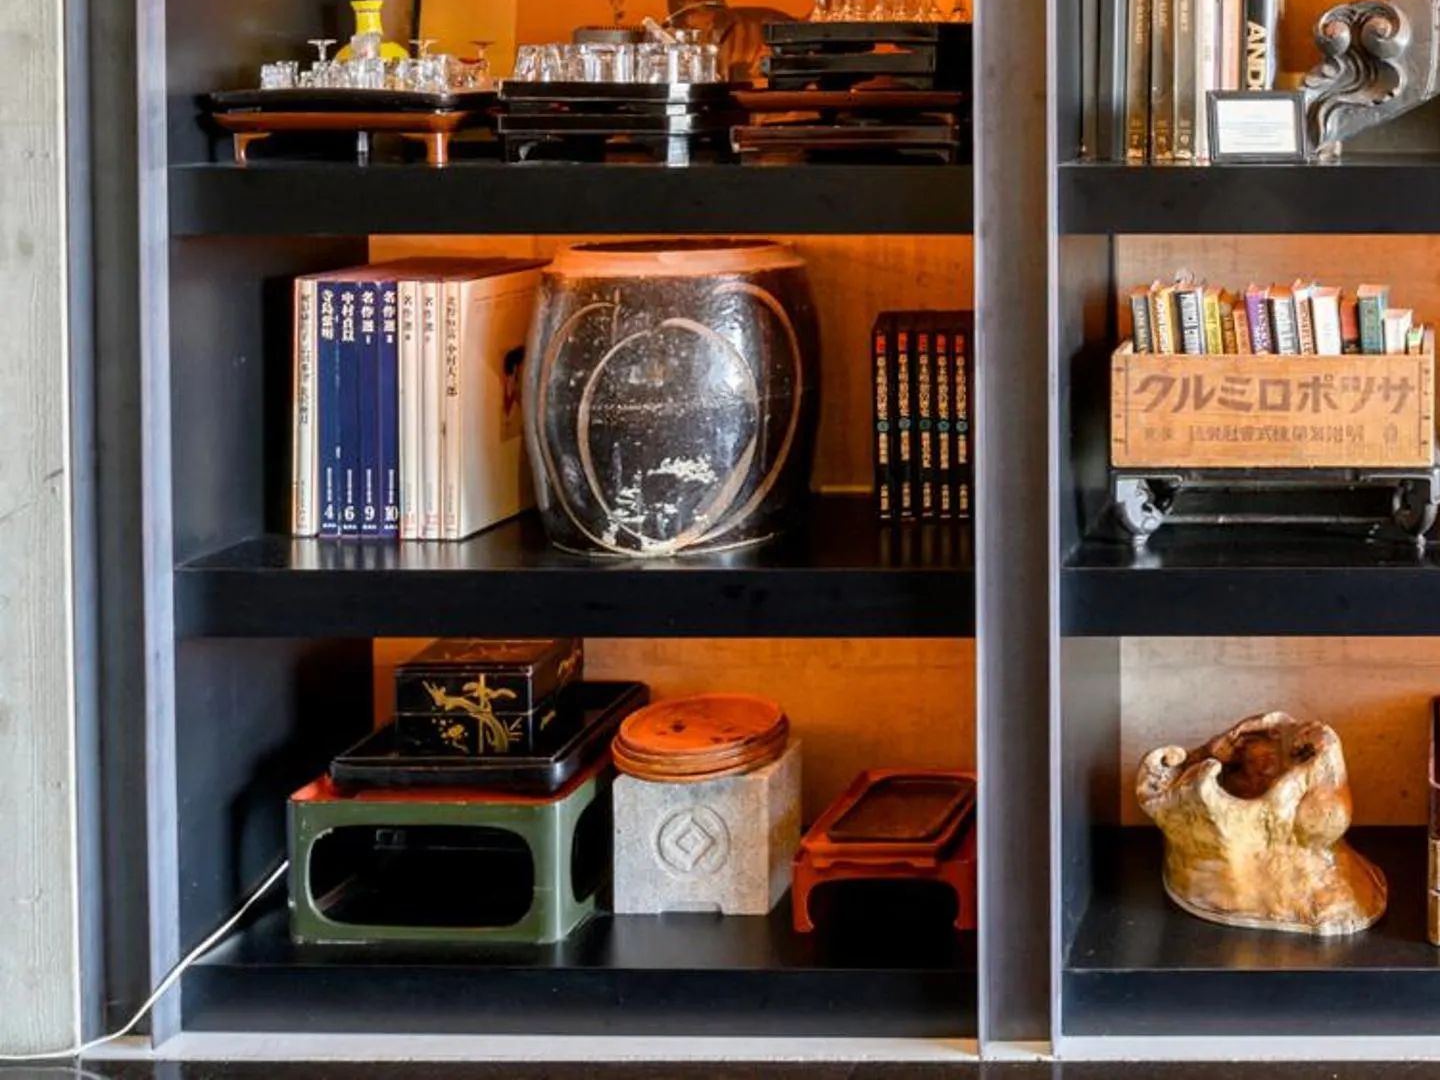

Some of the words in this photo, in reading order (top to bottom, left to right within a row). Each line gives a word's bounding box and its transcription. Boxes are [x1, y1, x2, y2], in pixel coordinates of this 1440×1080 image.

[1247, 21, 1267, 91] AND
[343, 505, 355, 522] 6
[363, 505, 376, 522] 9
[384, 505, 399, 522] 10
